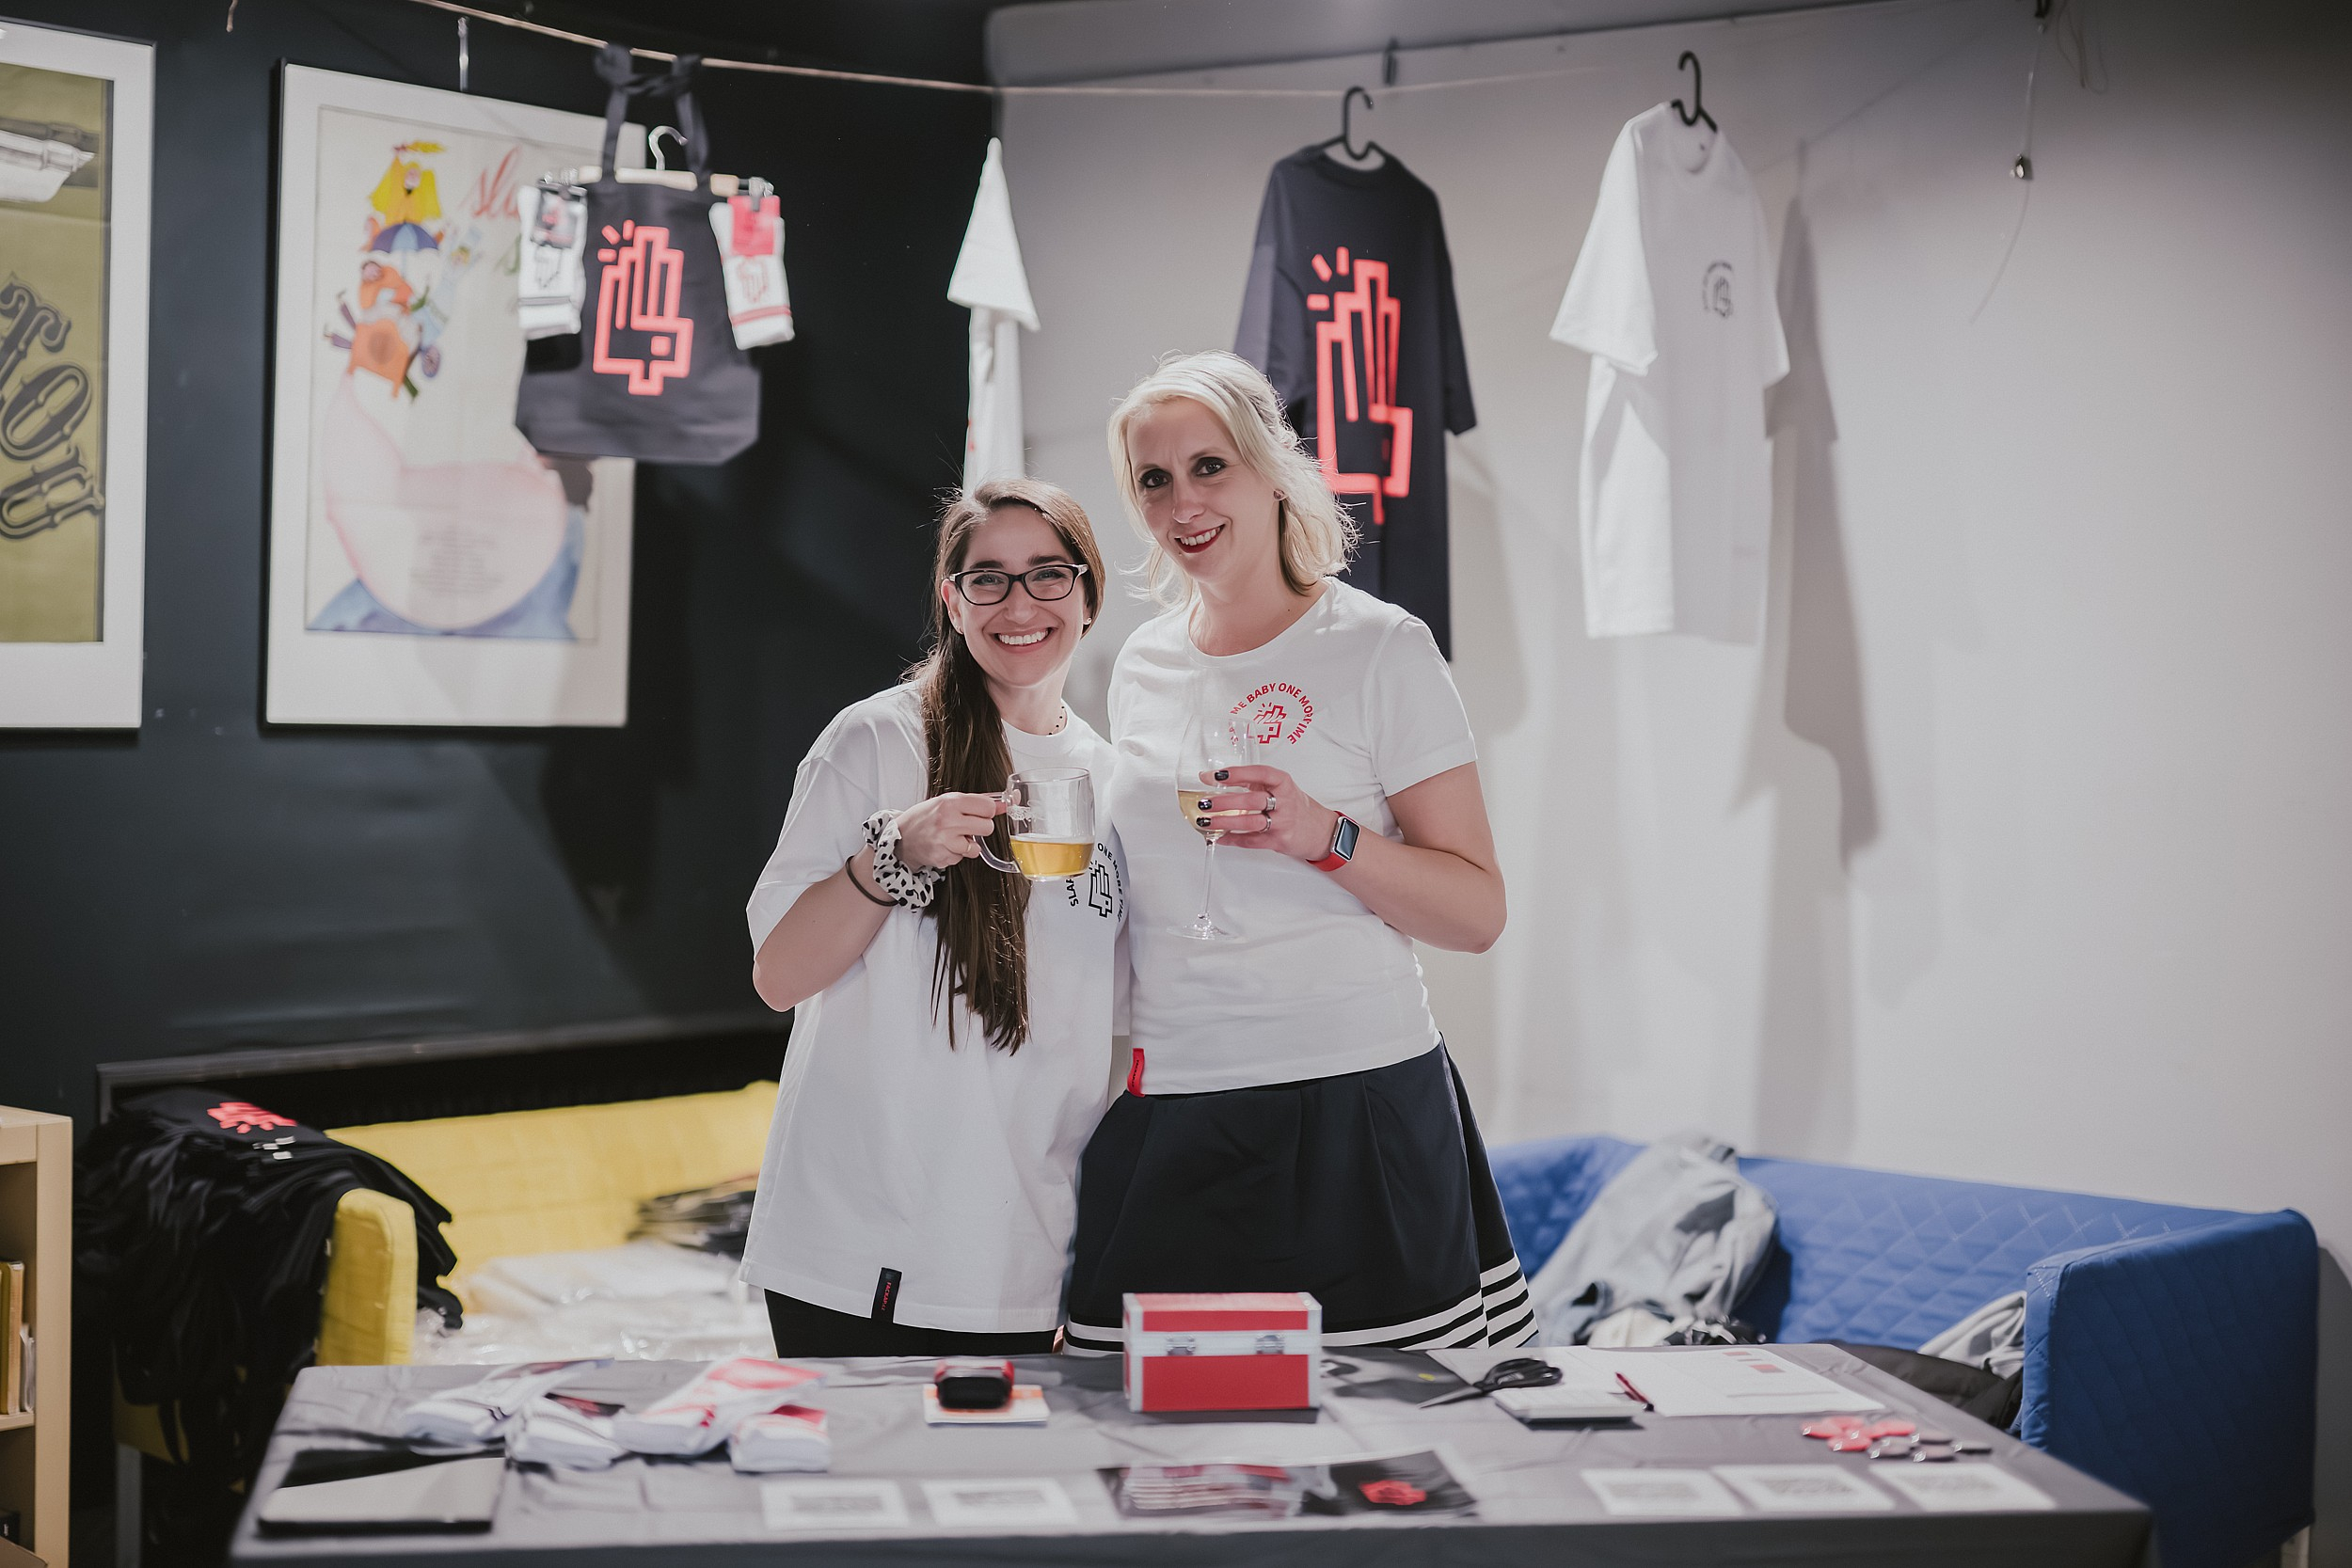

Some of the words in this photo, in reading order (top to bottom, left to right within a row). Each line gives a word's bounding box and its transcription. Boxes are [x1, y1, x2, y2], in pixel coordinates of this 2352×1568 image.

[1246, 683, 1277, 704] BABY
[1278, 682, 1302, 699] ONE
[1230, 701, 1248, 715] ME
[1286, 721, 1311, 745] IME
[1097, 842, 1113, 861] ONE
